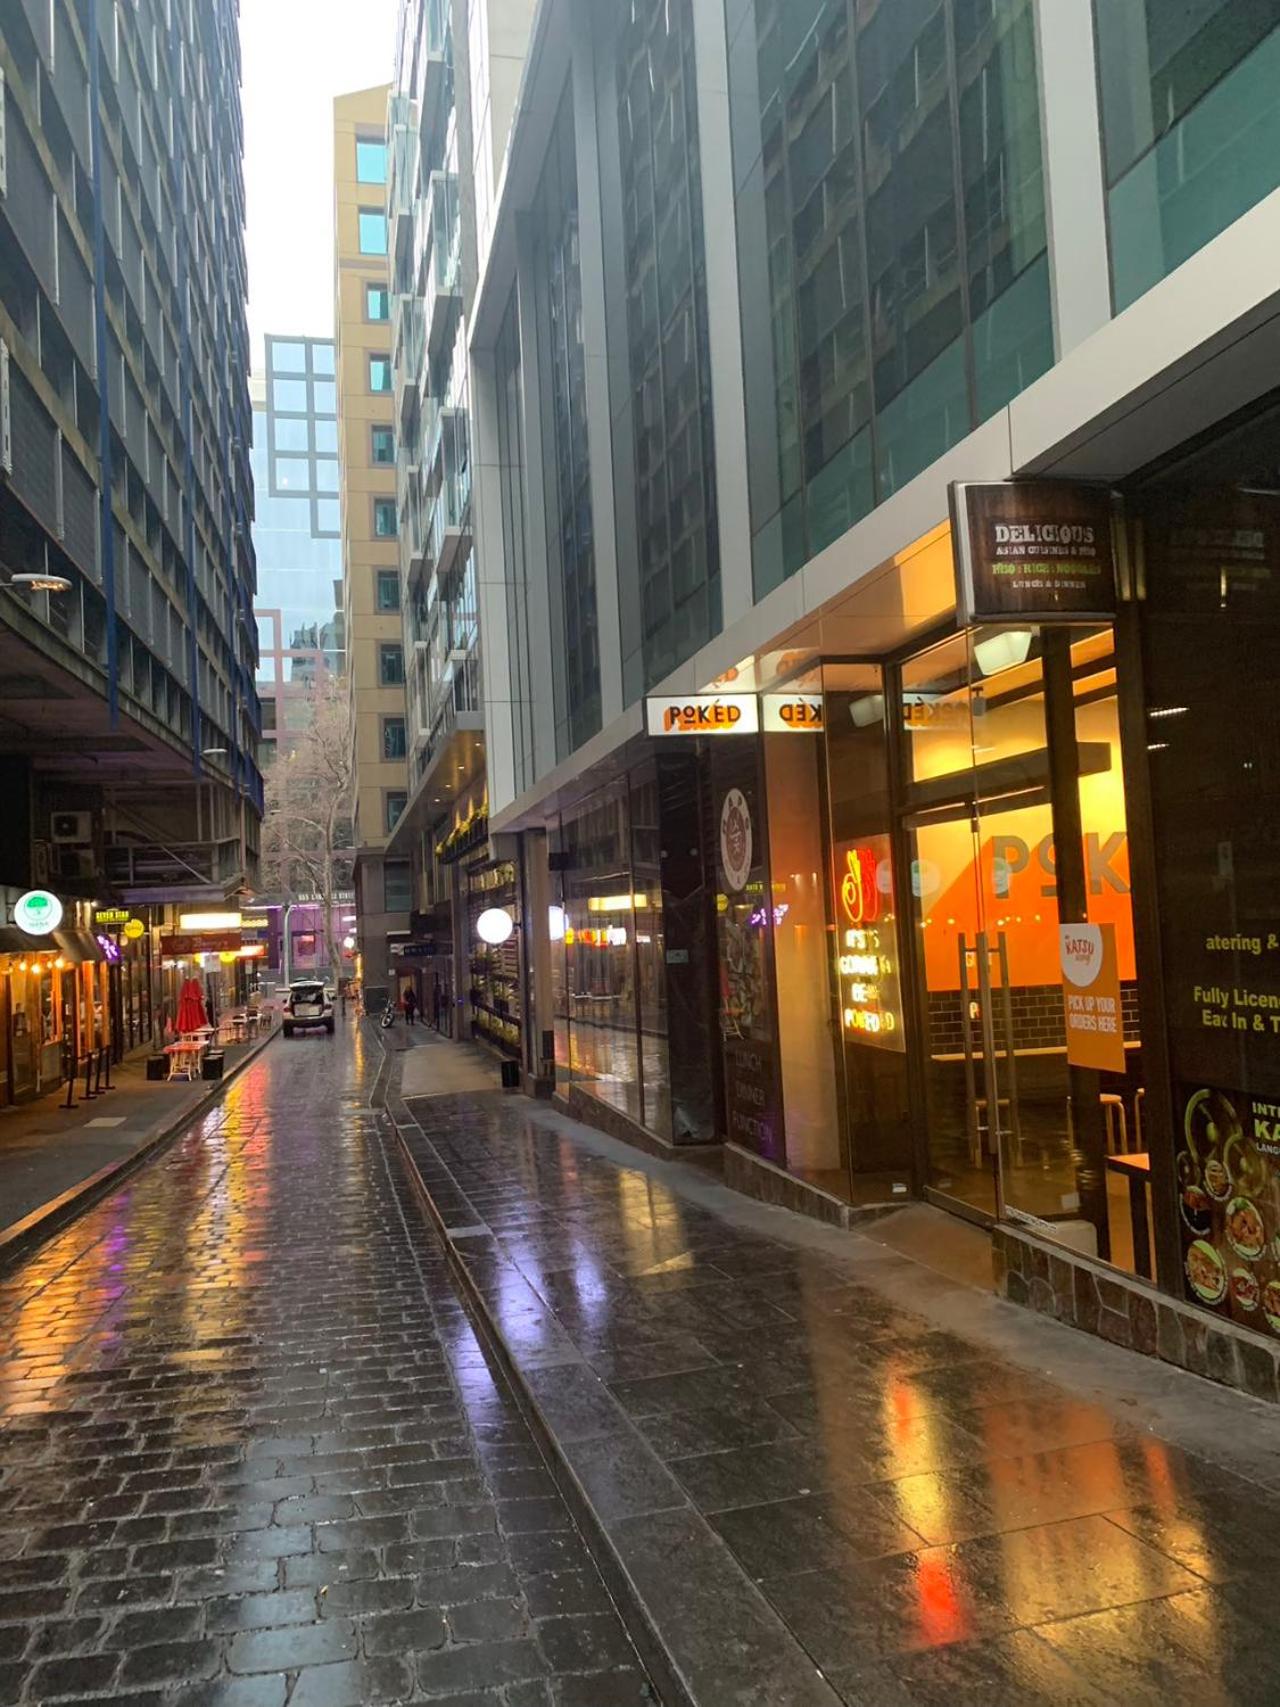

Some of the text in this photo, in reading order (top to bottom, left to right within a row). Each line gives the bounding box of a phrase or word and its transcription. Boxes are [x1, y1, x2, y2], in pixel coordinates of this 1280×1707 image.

[995, 524, 1095, 543] DELICIOUS
[996, 545, 1026, 556] ASIAN
[1065, 938, 1095, 955] KATSU
[1267, 933, 1279, 949] &
[1095, 996, 1116, 1013] YOUR
[1194, 986, 1280, 1008] Fully Licen
[1069, 1013, 1117, 1033] ORDERS HERE
[1202, 1009, 1228, 1028] Eat
[1232, 1012, 1247, 1030] In
[1253, 1014, 1265, 1031] &
